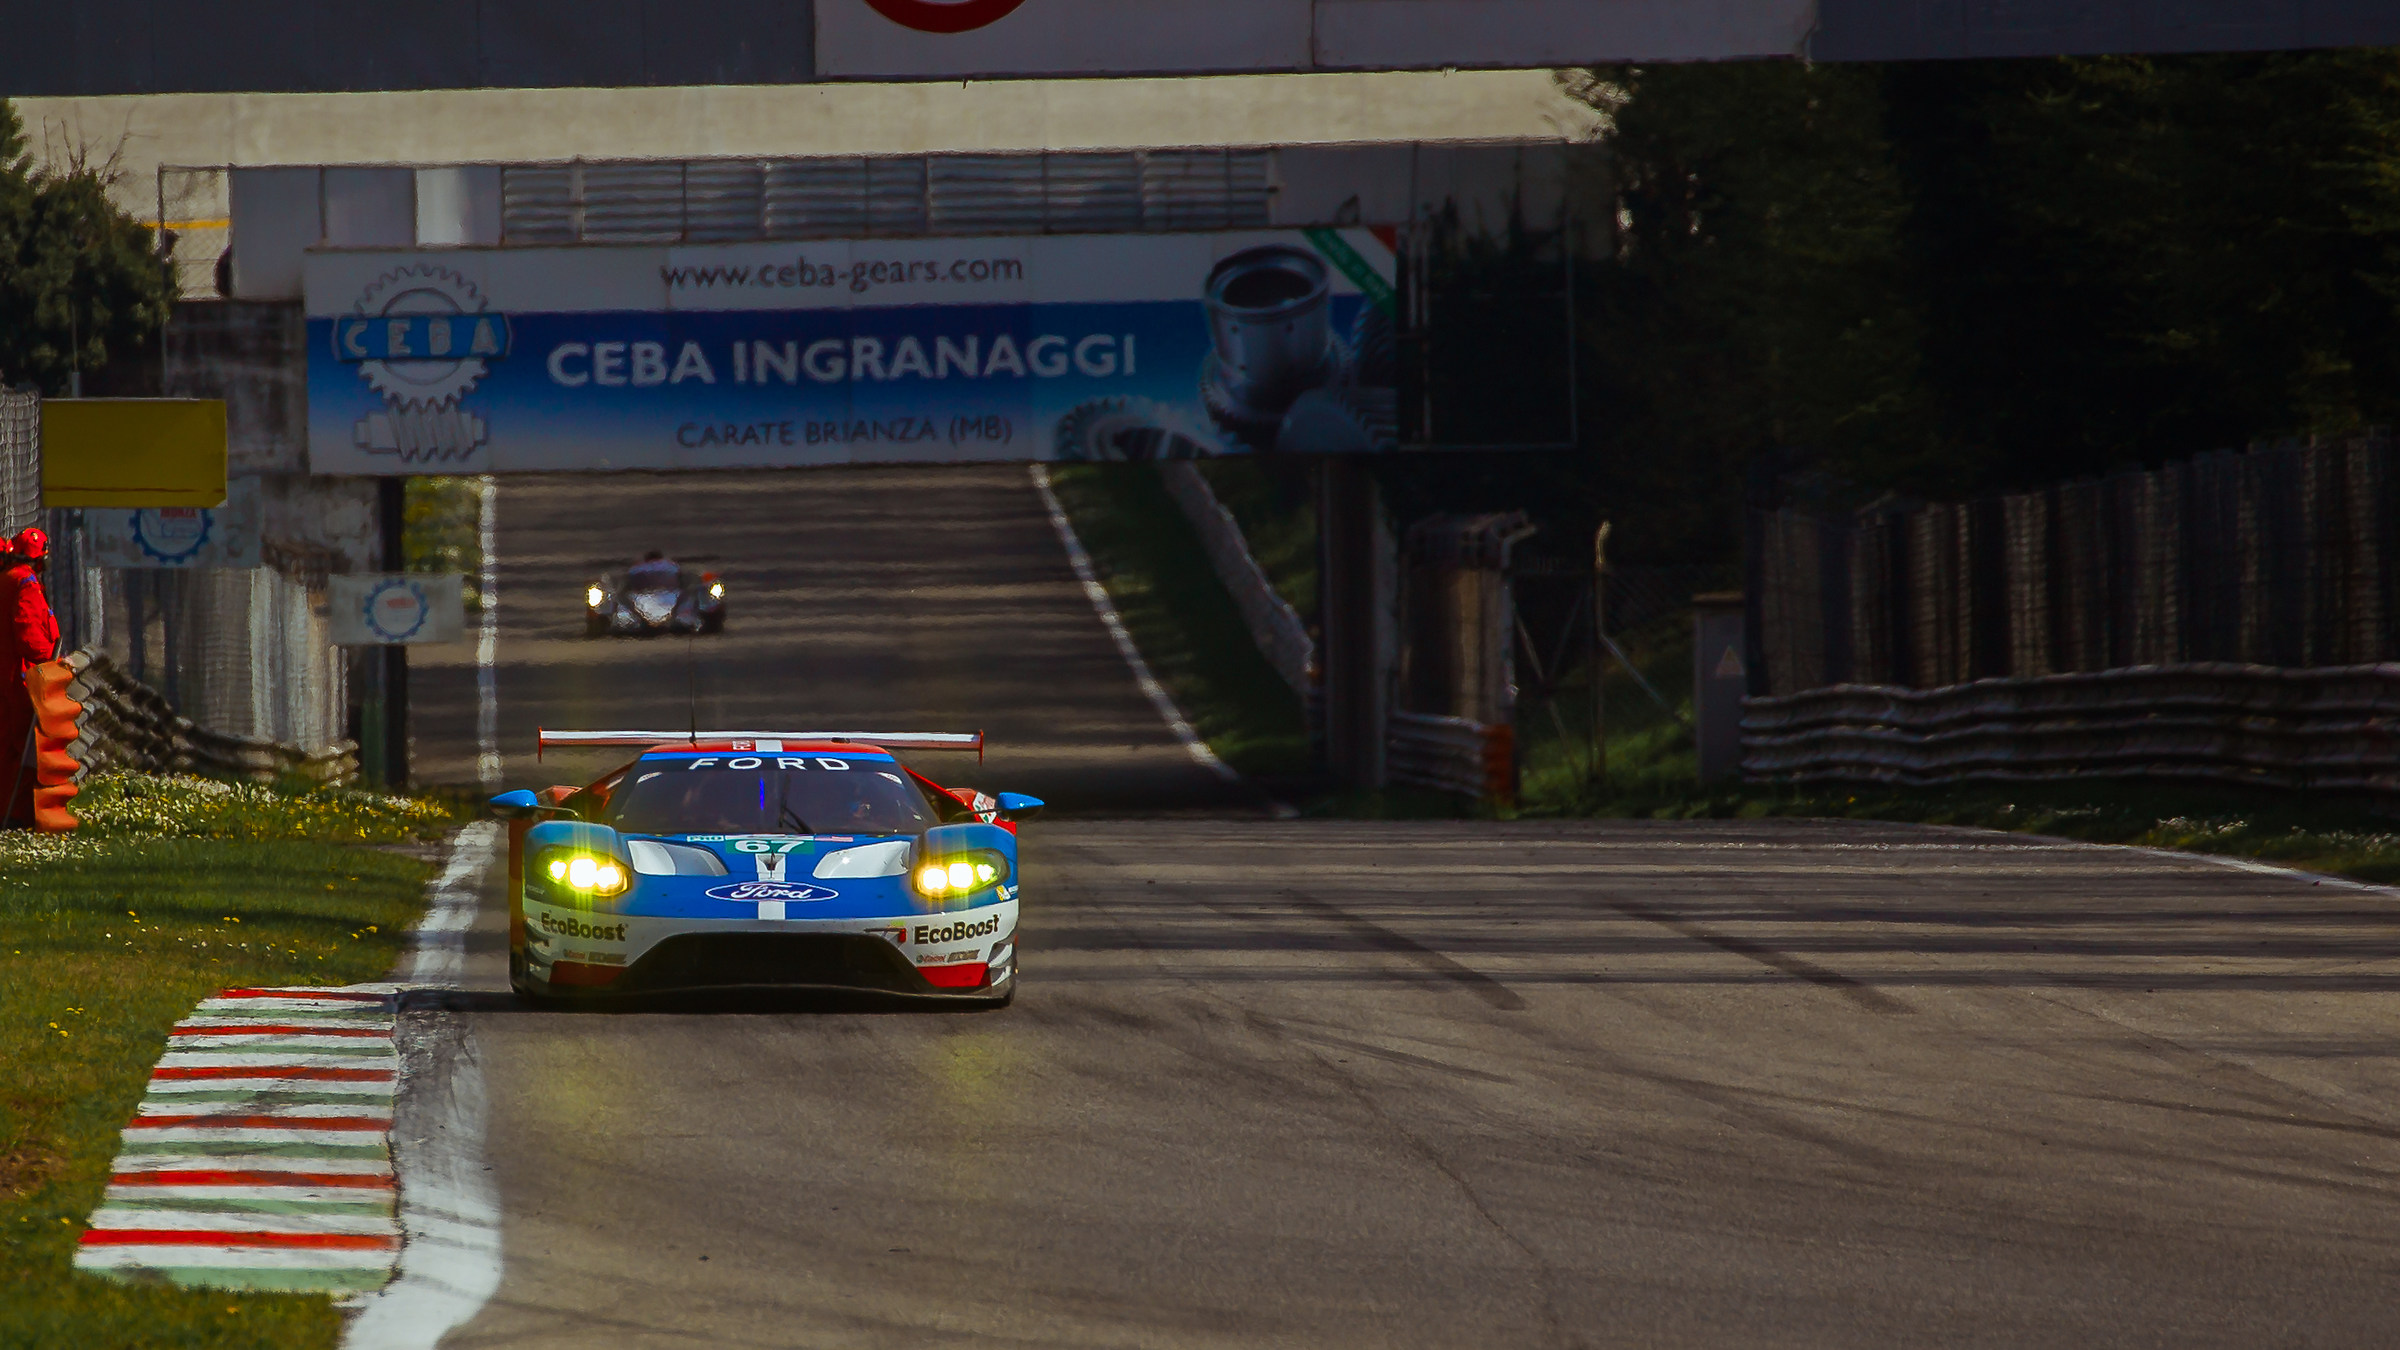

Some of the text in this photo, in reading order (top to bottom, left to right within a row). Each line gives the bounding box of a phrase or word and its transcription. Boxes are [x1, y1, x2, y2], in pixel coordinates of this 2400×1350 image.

[660, 255, 1022, 293] www.ceba-gears.com
[345, 317, 499, 356] CEBA
[547, 333, 1136, 386] CEBA INGRANAGGI
[677, 415, 1012, 447] CARATE BRIANZA (MB)
[688, 757, 850, 771] FORD
[734, 840, 806, 854] 67
[731, 883, 814, 900] Ford
[541, 911, 626, 942] EcoBoost
[914, 914, 999, 944] EcoBoost
